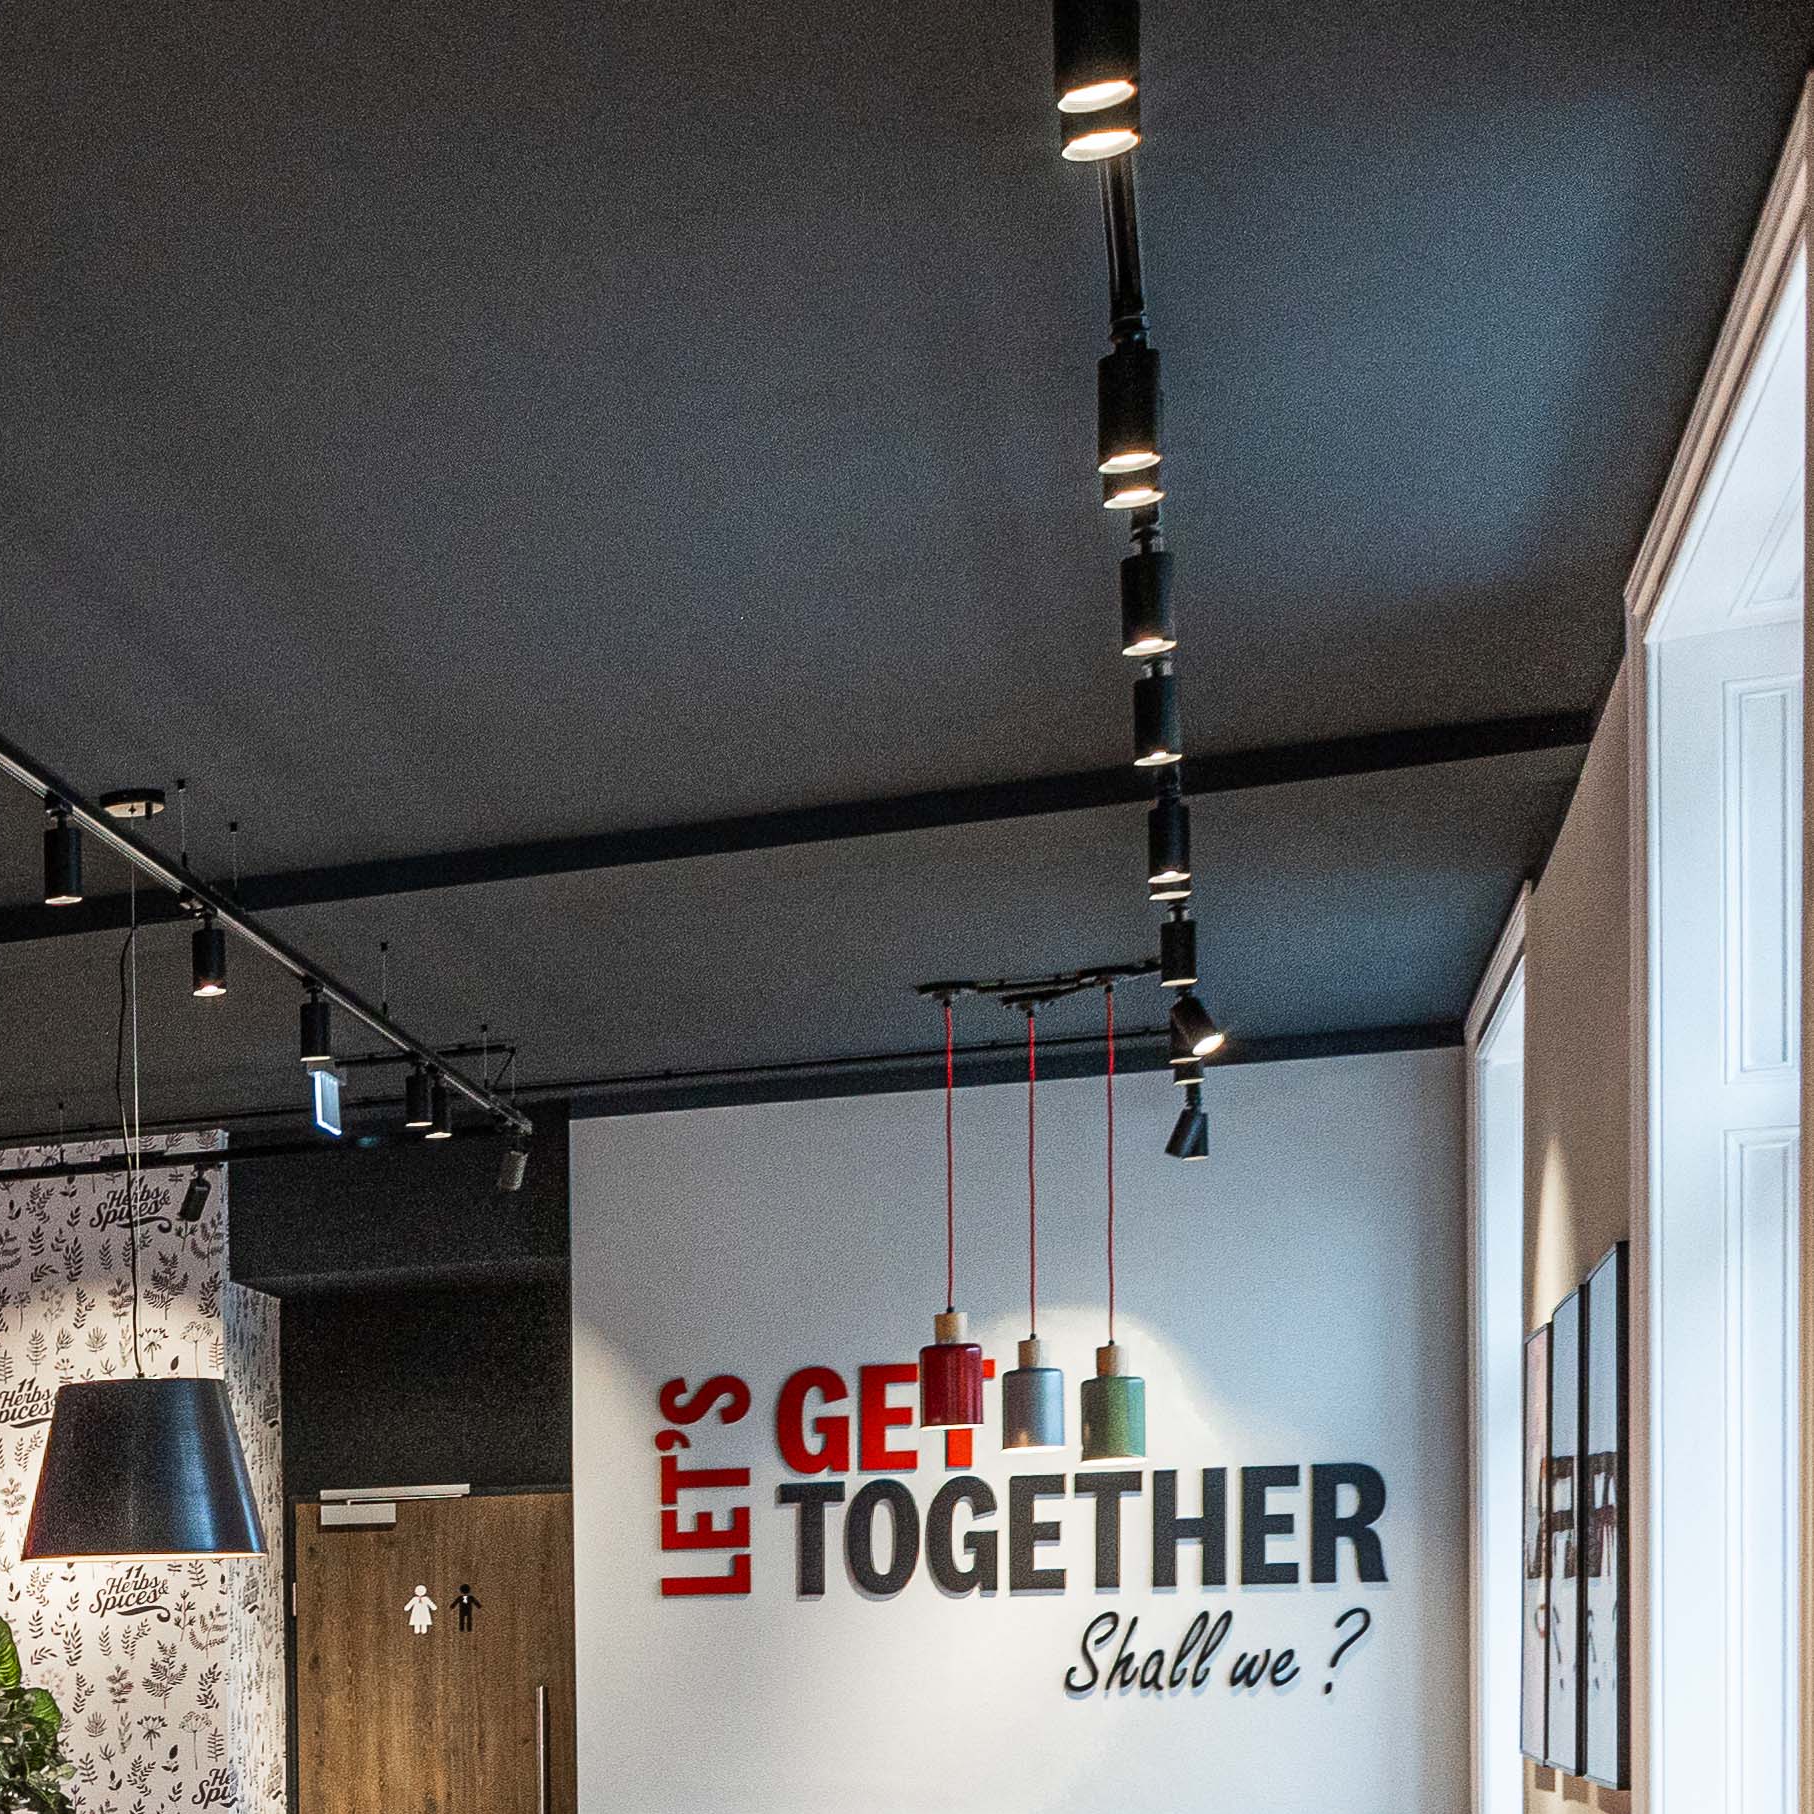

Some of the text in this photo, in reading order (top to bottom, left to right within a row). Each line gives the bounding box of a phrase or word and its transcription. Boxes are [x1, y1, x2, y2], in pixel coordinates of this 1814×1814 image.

[0, 1386, 51, 1409] Herbs
[18, 1377, 36, 1393] 11
[655, 1374, 751, 1596] LET'S
[779, 1462, 1390, 1596] TOGETHER
[106, 1573, 169, 1595] Herbs &
[126, 1564, 144, 1580] 11
[89, 1588, 161, 1618] Spices
[1065, 1609, 1233, 1692] Shall
[1230, 1648, 1301, 1688] we
